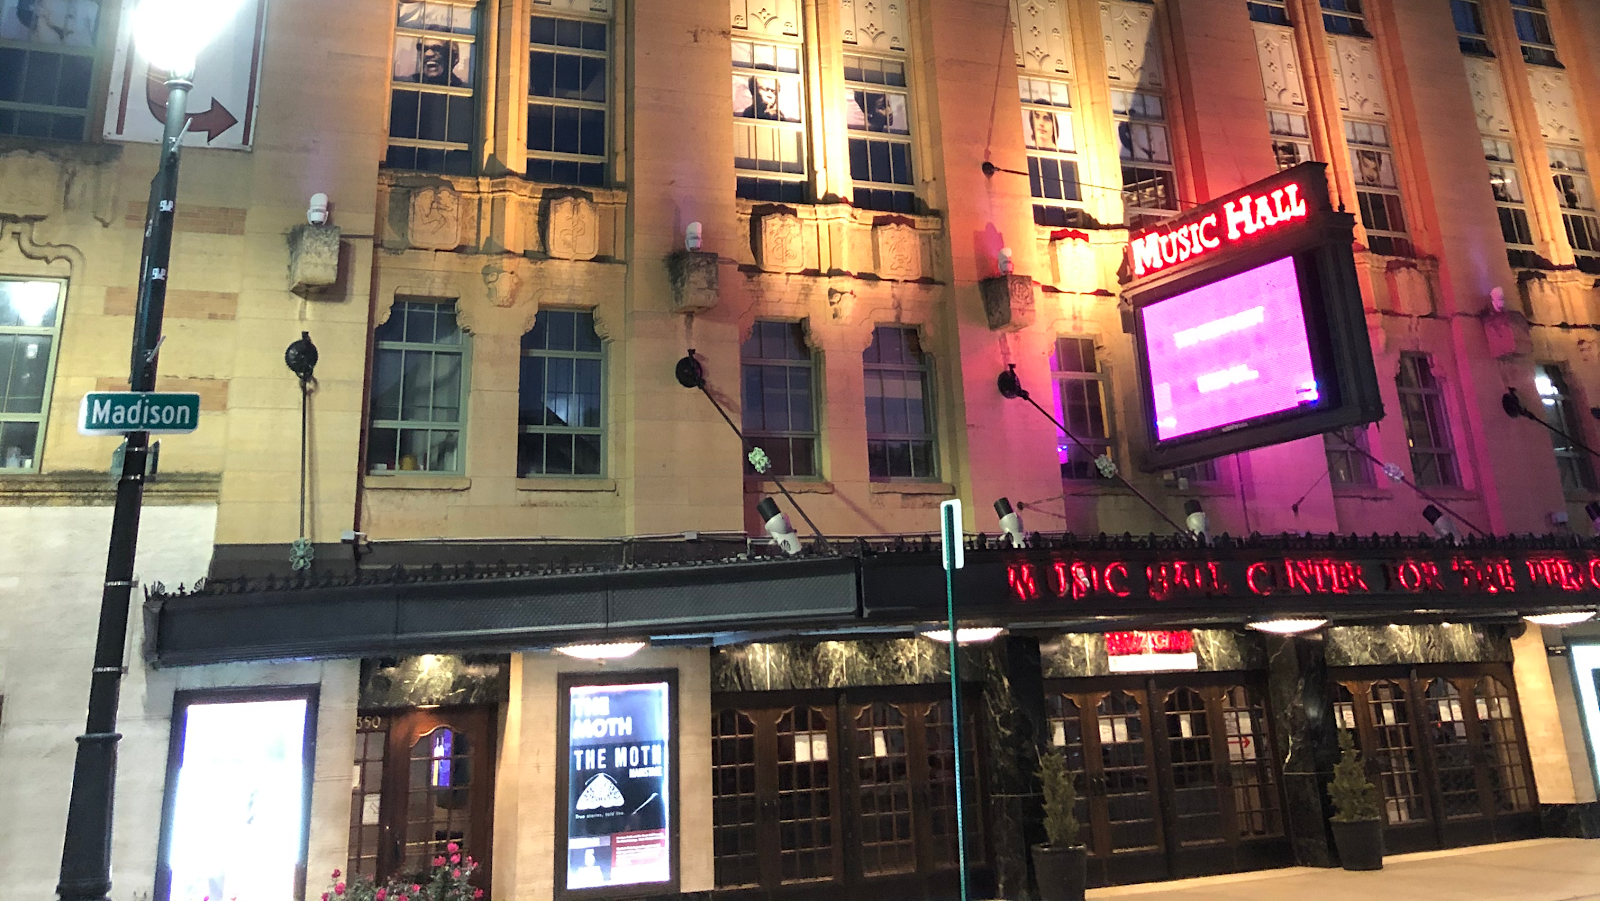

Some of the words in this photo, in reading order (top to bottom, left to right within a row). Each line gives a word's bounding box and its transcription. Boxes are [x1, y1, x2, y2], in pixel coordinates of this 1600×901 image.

[1130, 213, 1220, 275] MUSIC
[1223, 183, 1306, 240] HALL
[91, 398, 191, 425] Madison
[572, 716, 633, 739] MOTH
[573, 748, 607, 771] THE
[614, 744, 662, 768] MOTH
